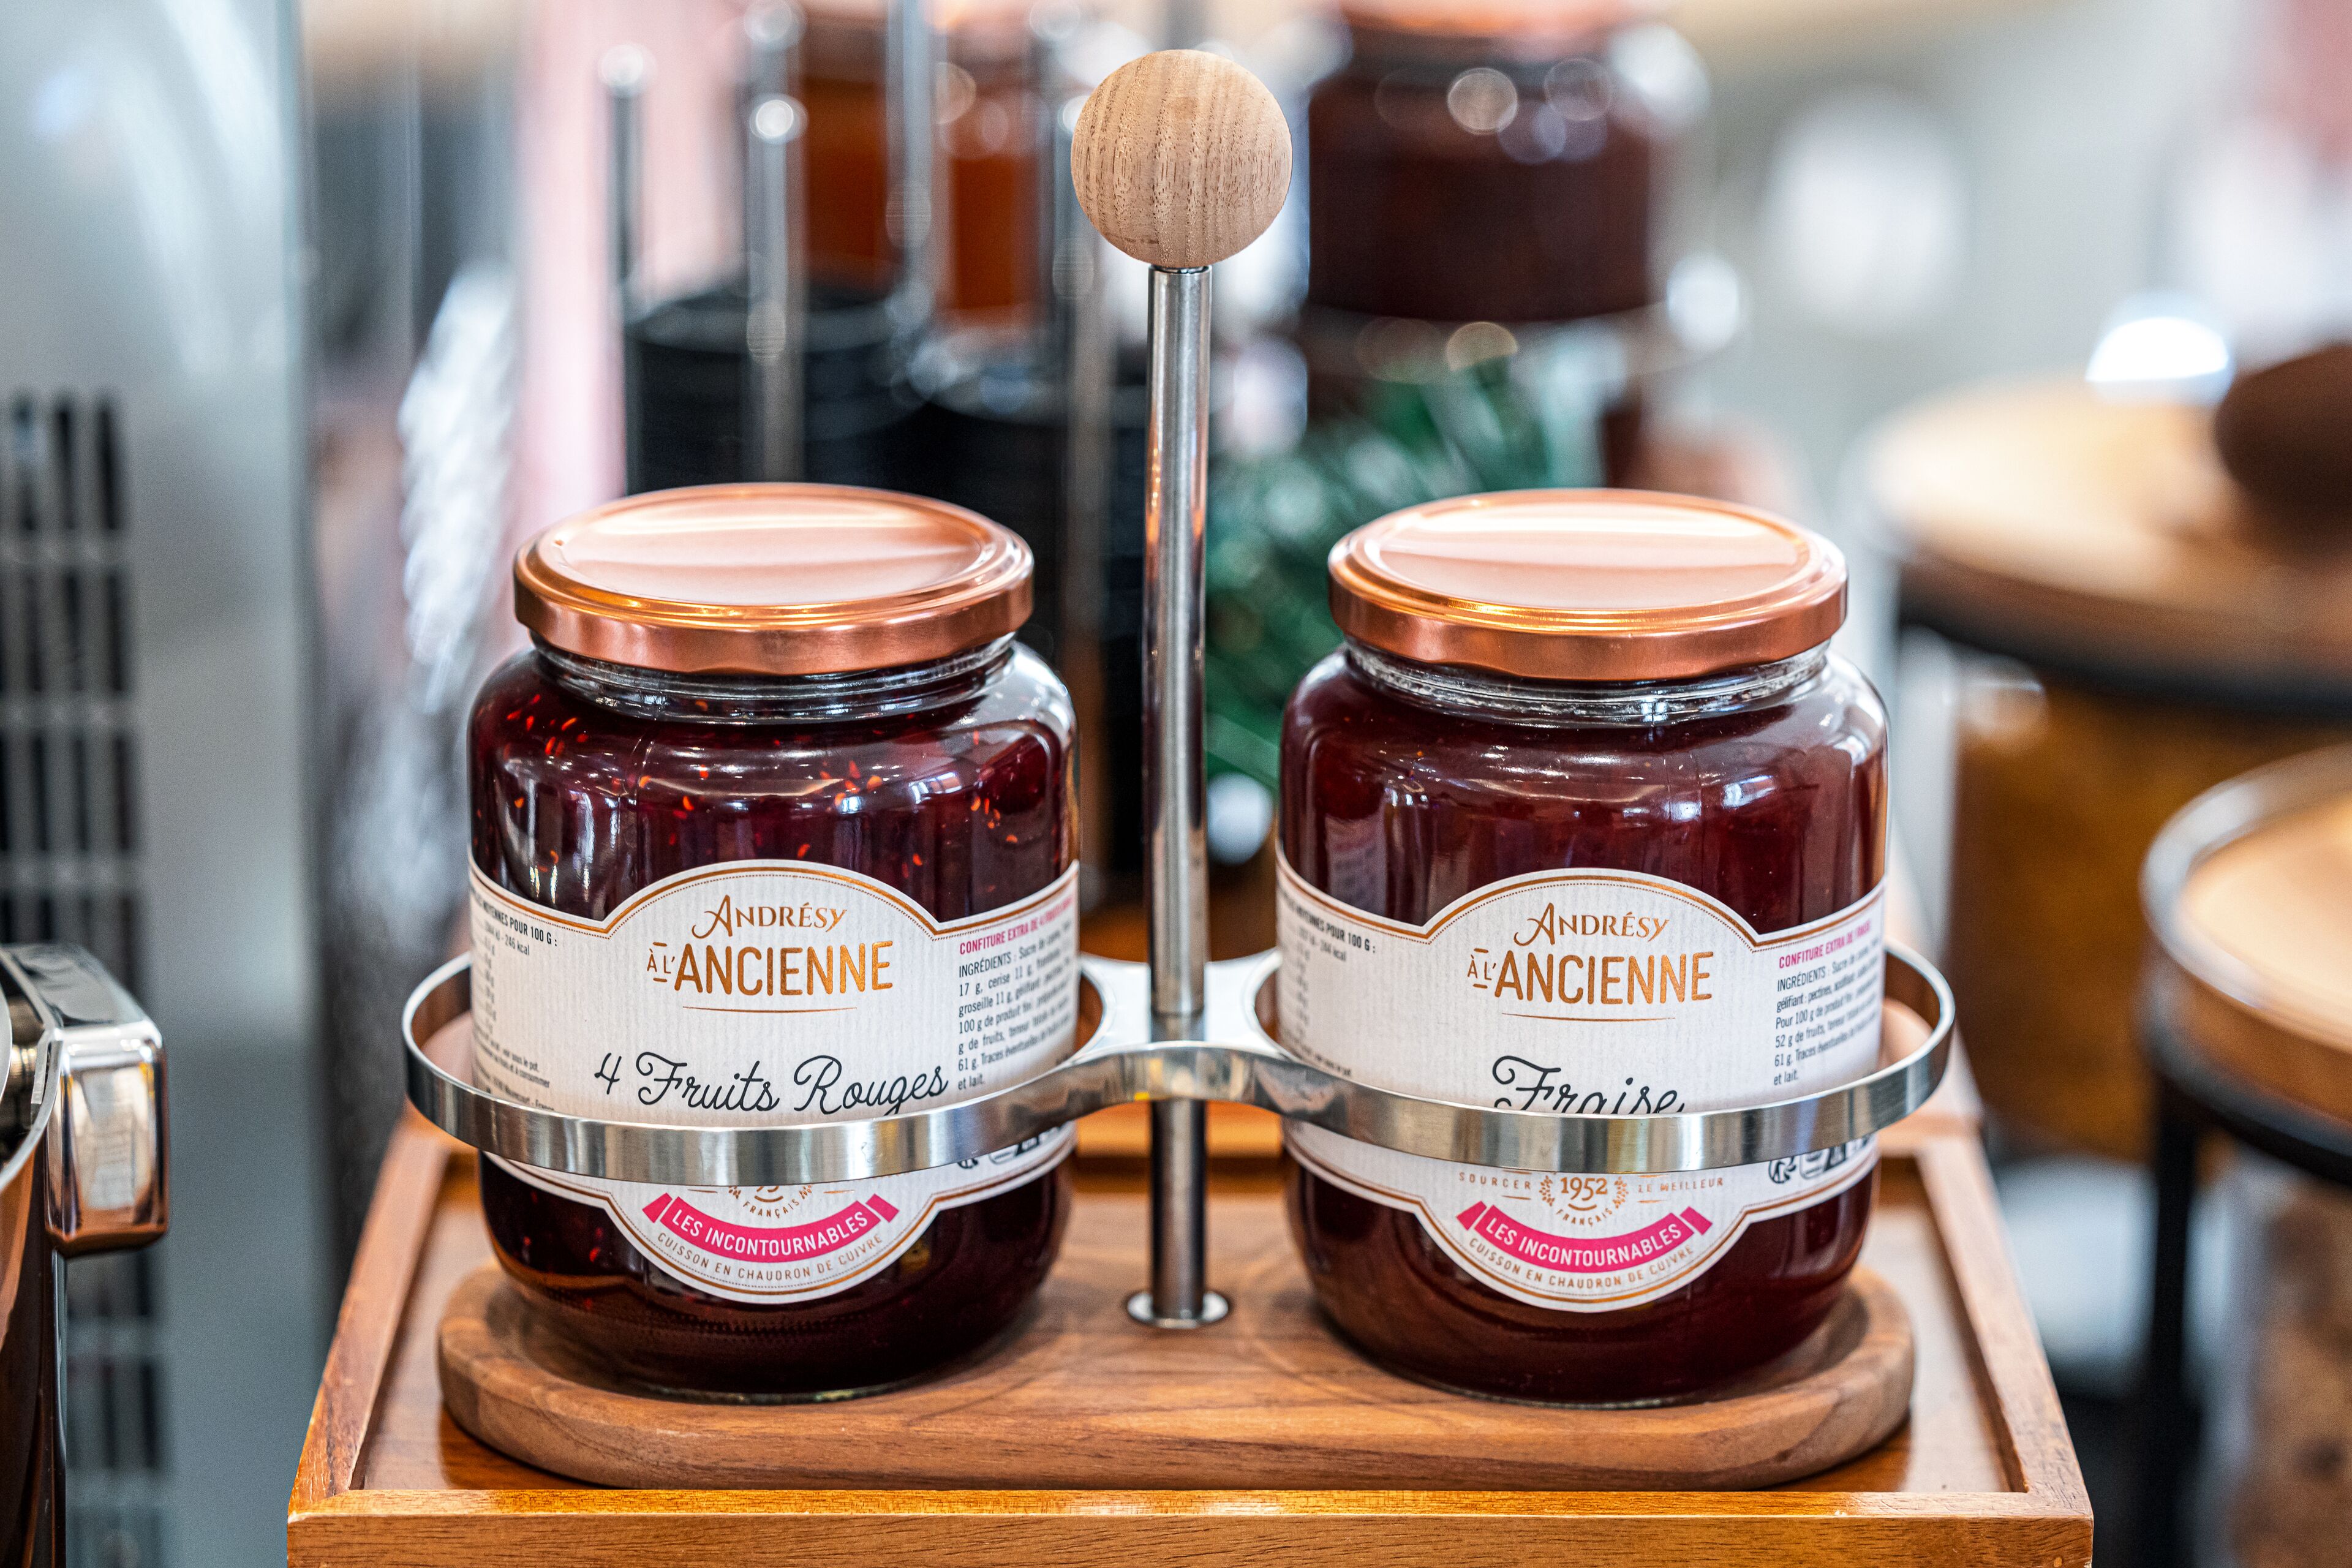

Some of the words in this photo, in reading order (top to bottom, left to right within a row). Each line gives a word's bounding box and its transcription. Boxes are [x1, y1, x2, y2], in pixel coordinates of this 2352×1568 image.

[510, 918, 528, 936] POUR
[531, 926, 544, 941] 100
[547, 932, 552, 944] G
[960, 931, 1005, 955] CONFITURE
[1008, 923, 1028, 941] EXTRA
[1327, 922, 1345, 941] POUR
[1348, 932, 1362, 948] 100
[1365, 939, 1370, 951] G
[505, 935, 515, 949] 246
[517, 941, 529, 956] kcal
[1779, 944, 1823, 968] CONFITURE
[1825, 937, 1845, 954] EXTRA
[959, 952, 1011, 978] INGRÉDIENTS
[959, 983, 970, 997] 17
[988, 973, 1010, 989] cerise
[1777, 966, 1825, 992] INGRÉDIENTS
[959, 997, 993, 1017] groseille
[996, 992, 1004, 1005] 11
[1777, 992, 1803, 1013] gélifiant
[959, 1019, 974, 1034] 100
[978, 1020, 982, 1031] g
[984, 1015, 993, 1027] de
[1776, 1017, 1793, 1029] Pour
[1795, 1009, 1807, 1025] 100
[1809, 1009, 1814, 1022] g
[1815, 1007, 1823, 1017] de
[959, 1043, 963, 1055] g
[968, 1039, 978, 1050] de
[1776, 1035, 1785, 1048] 52
[1789, 1035, 1792, 1047] g
[1795, 1031, 1803, 1042] de
[959, 1059, 968, 1071] 61
[981, 1049, 1003, 1065] Traces
[1774, 1055, 1784, 1066] 61
[1796, 1046, 1816, 1061] Traces
[594, 1052, 622, 1095] 4
[636, 1052, 780, 1111] Fruits
[793, 1055, 949, 1116] Rouges
[958, 1077, 967, 1090] et
[1774, 1074, 1781, 1085] et
[1459, 1172, 1531, 1190] SOURCER
[1560, 1175, 1608, 1201] 1952
[1638, 1184, 1652, 1193] LE
[1660, 1177, 1723, 1191] MEILLEUR
[743, 1199, 799, 1218] FRANÇAIS
[1556, 1207, 1613, 1227] FRANÇAIS
[673, 1208, 702, 1237] LES
[705, 1212, 868, 1257] INCONTOURNABLES
[1486, 1217, 1517, 1246] LES
[1518, 1223, 1682, 1267] INCONTOURNABLES
[657, 1232, 709, 1268] CUISSON
[715, 1263, 731, 1275] EN
[738, 1266, 810, 1281] CHAUDRON
[817, 1260, 832, 1274] DE
[839, 1234, 883, 1266] CUIVRE
[1469, 1238, 1521, 1275] CUISSON
[1526, 1269, 1542, 1282] EN
[1549, 1275, 1622, 1289] CHAUDRON
[1629, 1271, 1643, 1283] DE
[1649, 1245, 1694, 1275] CUIVRE
